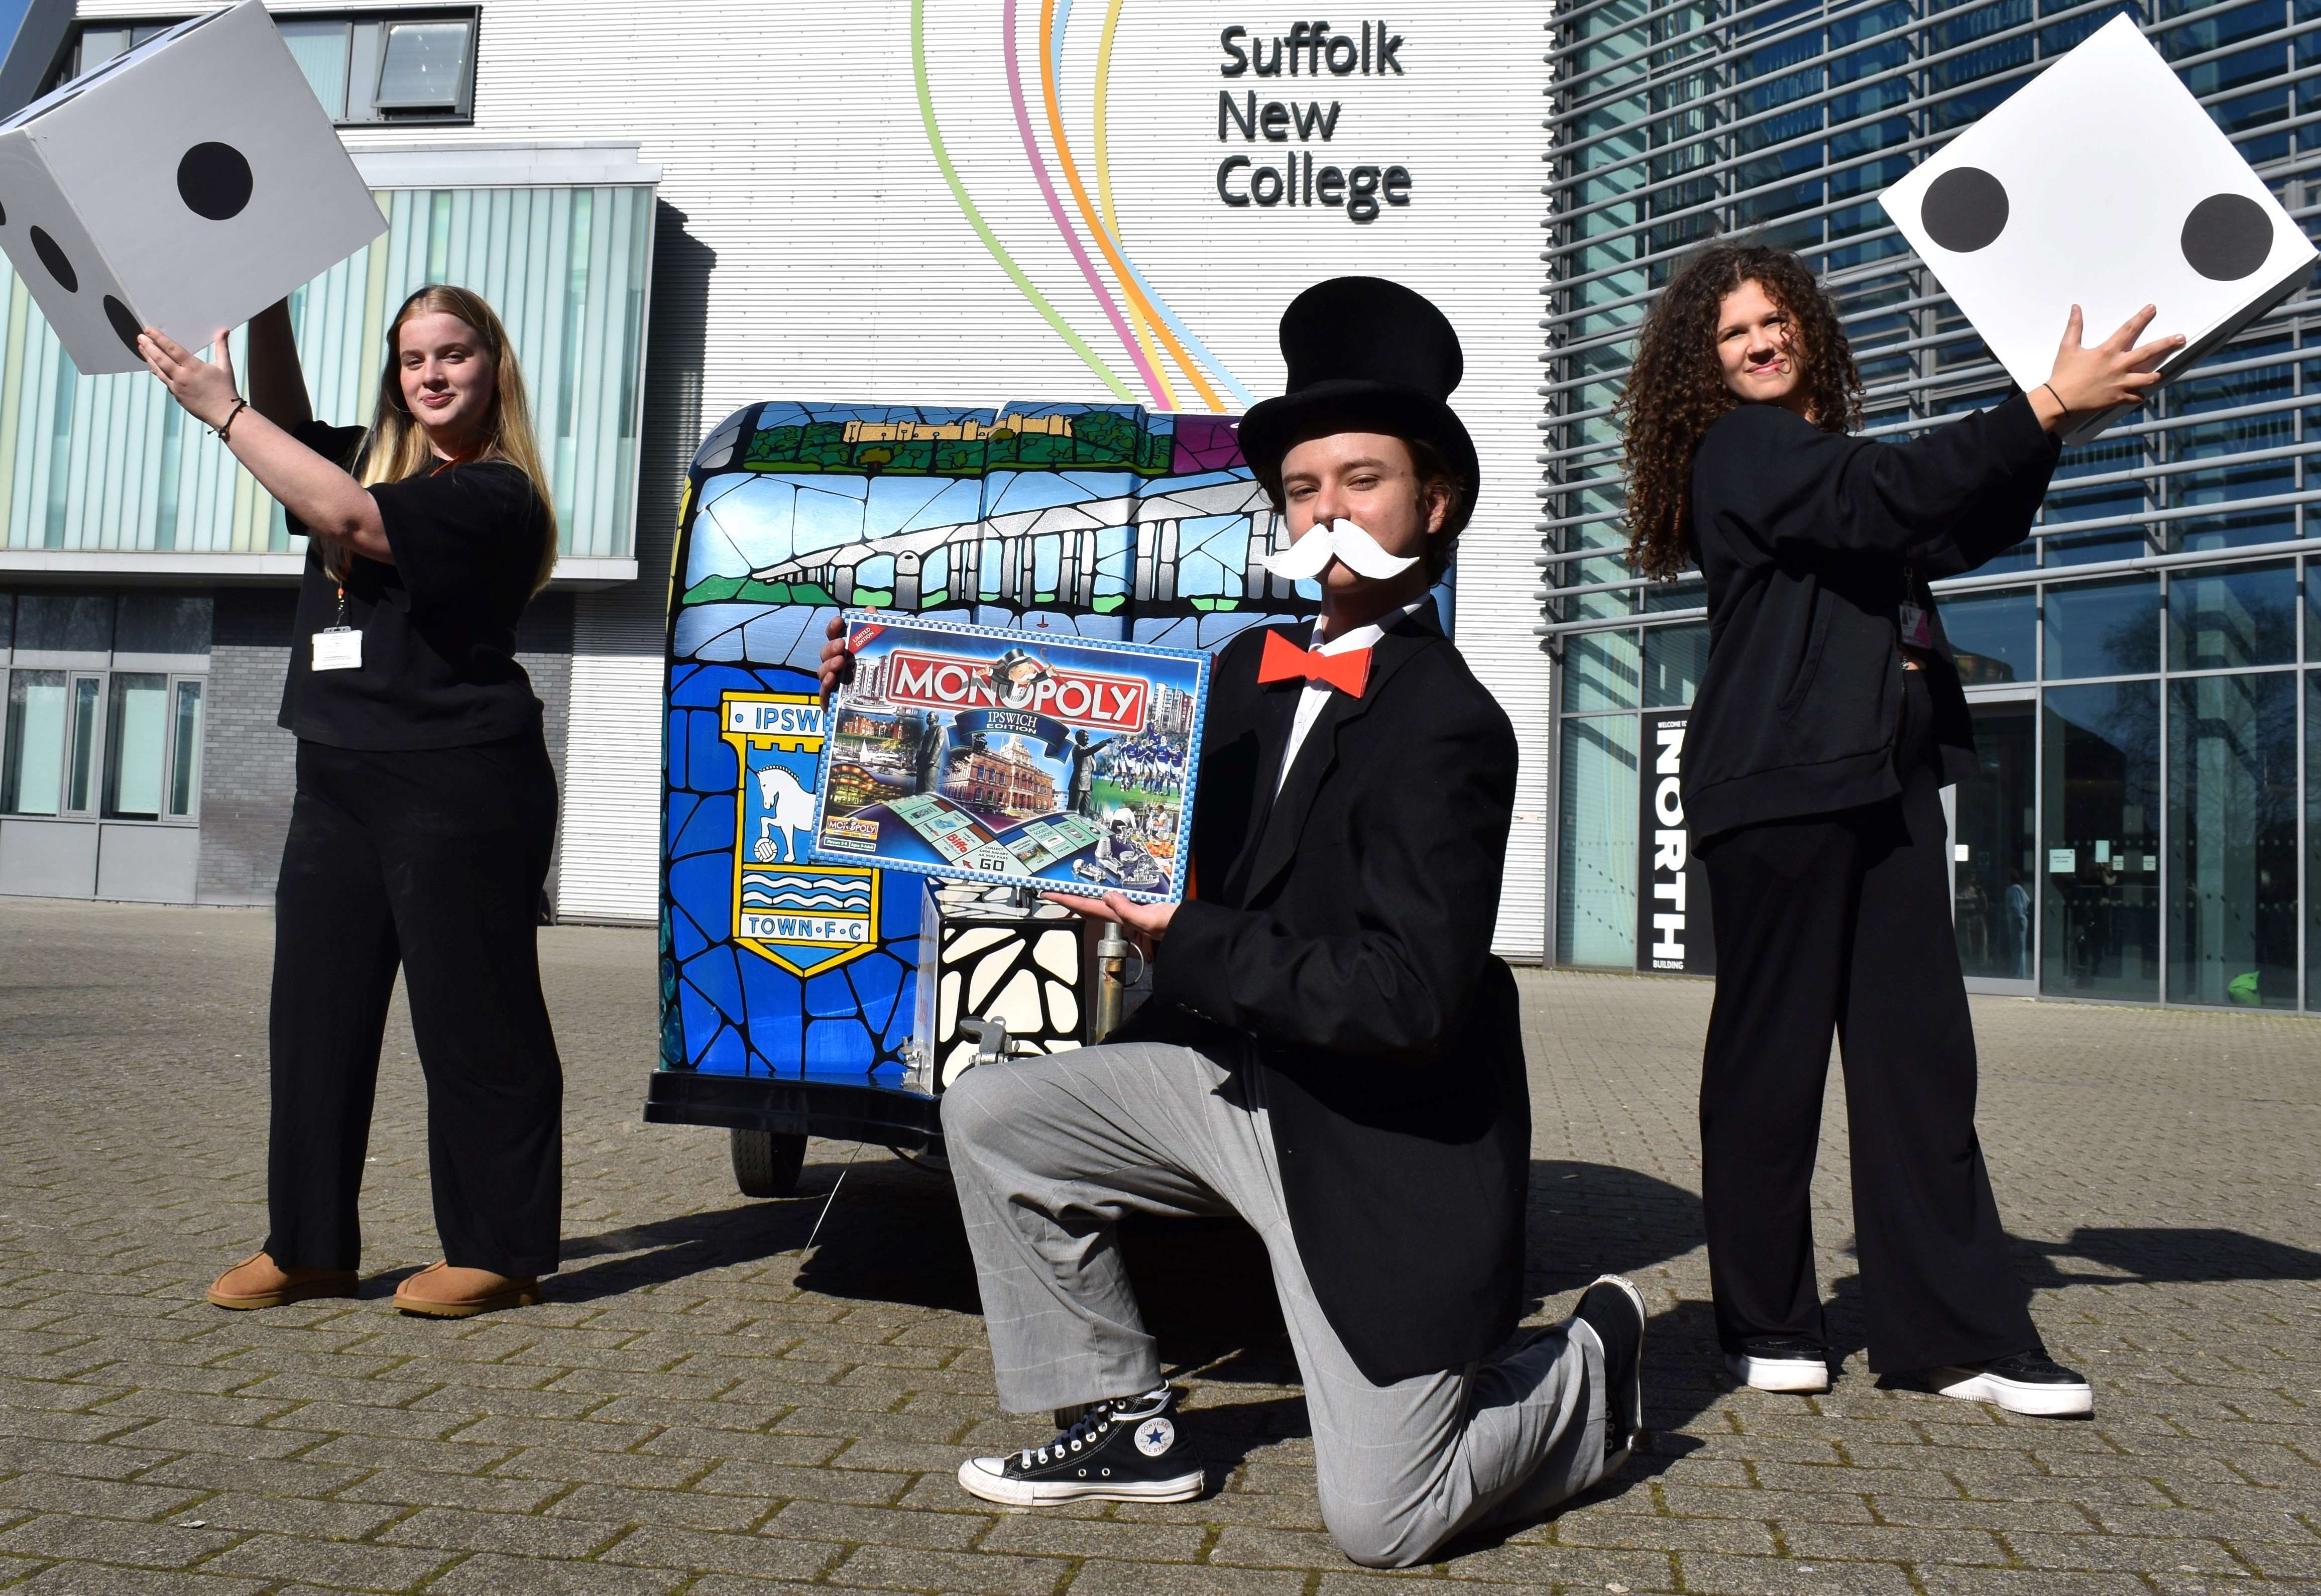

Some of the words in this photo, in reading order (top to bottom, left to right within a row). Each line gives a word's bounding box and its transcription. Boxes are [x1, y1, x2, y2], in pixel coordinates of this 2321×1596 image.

[1220, 20, 1405, 75] Suffolk
[1218, 90, 1341, 140] New
[1216, 151, 1412, 221] College
[853, 627, 871, 643] LIMITED
[855, 631, 874, 647] EDITION
[895, 659, 1138, 721] MONOPOLY
[988, 711, 1038, 728] IPSWICH
[986, 723, 1037, 734] EDITION
[829, 821, 875, 833] MONOPOLY
[1653, 729, 1686, 960] NORTH
[980, 858, 1004, 871] GO
[1653, 960, 1684, 970] BUILDING
[1140, 1421, 1170, 1434] CONVERSE
[1141, 1444, 1151, 1452] ALL
[1153, 1442, 1169, 1452] STAR
